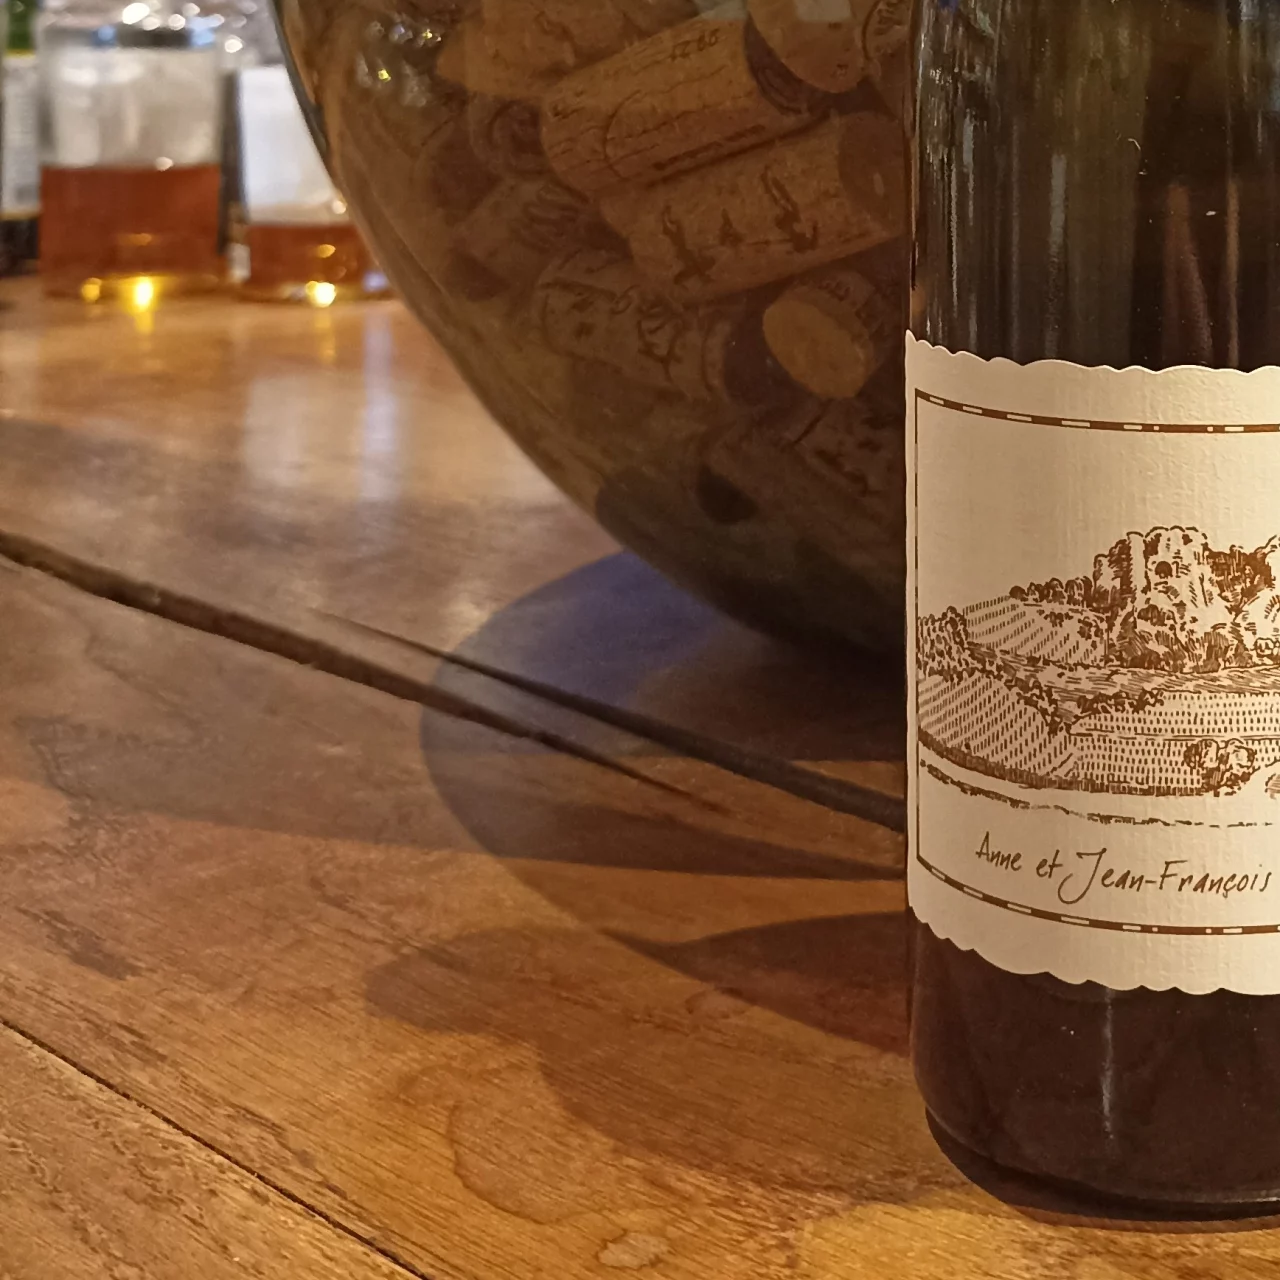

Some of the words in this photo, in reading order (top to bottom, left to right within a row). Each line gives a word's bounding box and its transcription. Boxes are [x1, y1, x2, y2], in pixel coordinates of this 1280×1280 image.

[974, 830, 1023, 872] Anne
[1035, 849, 1064, 879] et
[1056, 846, 1273, 905] Jean-François
